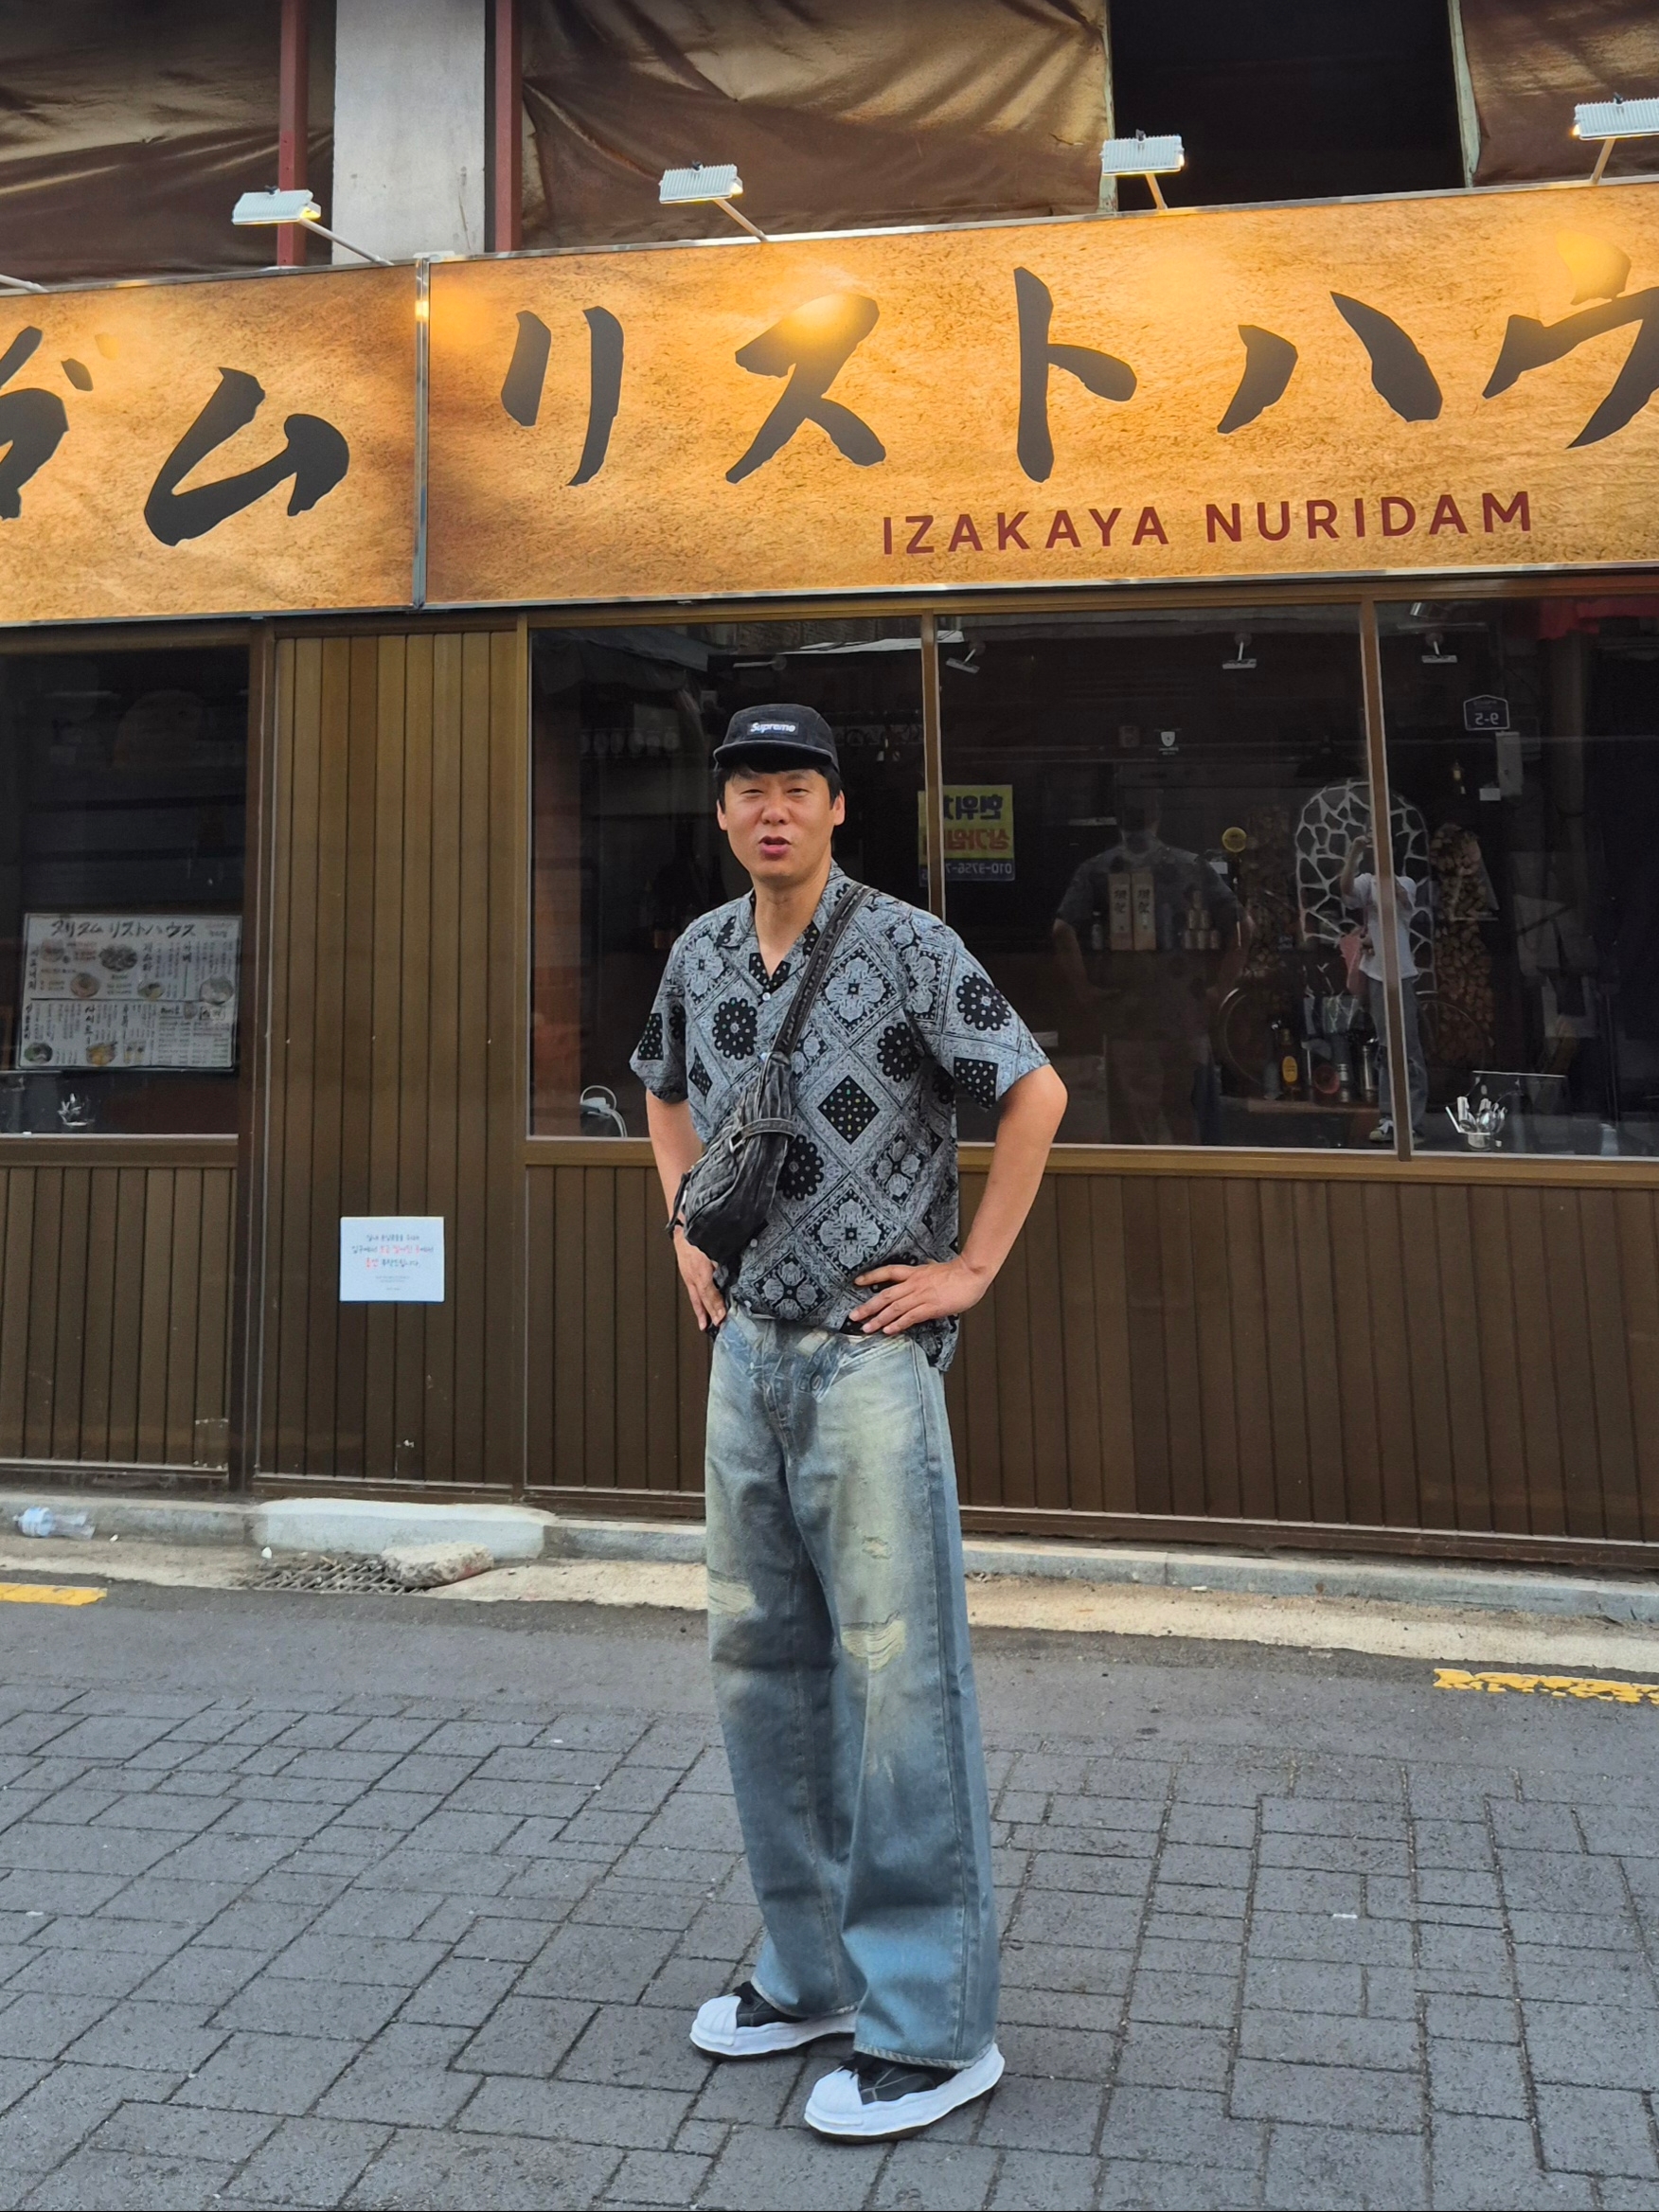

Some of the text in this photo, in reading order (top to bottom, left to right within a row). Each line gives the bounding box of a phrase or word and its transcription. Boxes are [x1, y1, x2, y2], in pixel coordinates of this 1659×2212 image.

[883, 491, 1531, 556] IZAKAYA NURIDAM
[750, 722, 796, 734] Supreme
